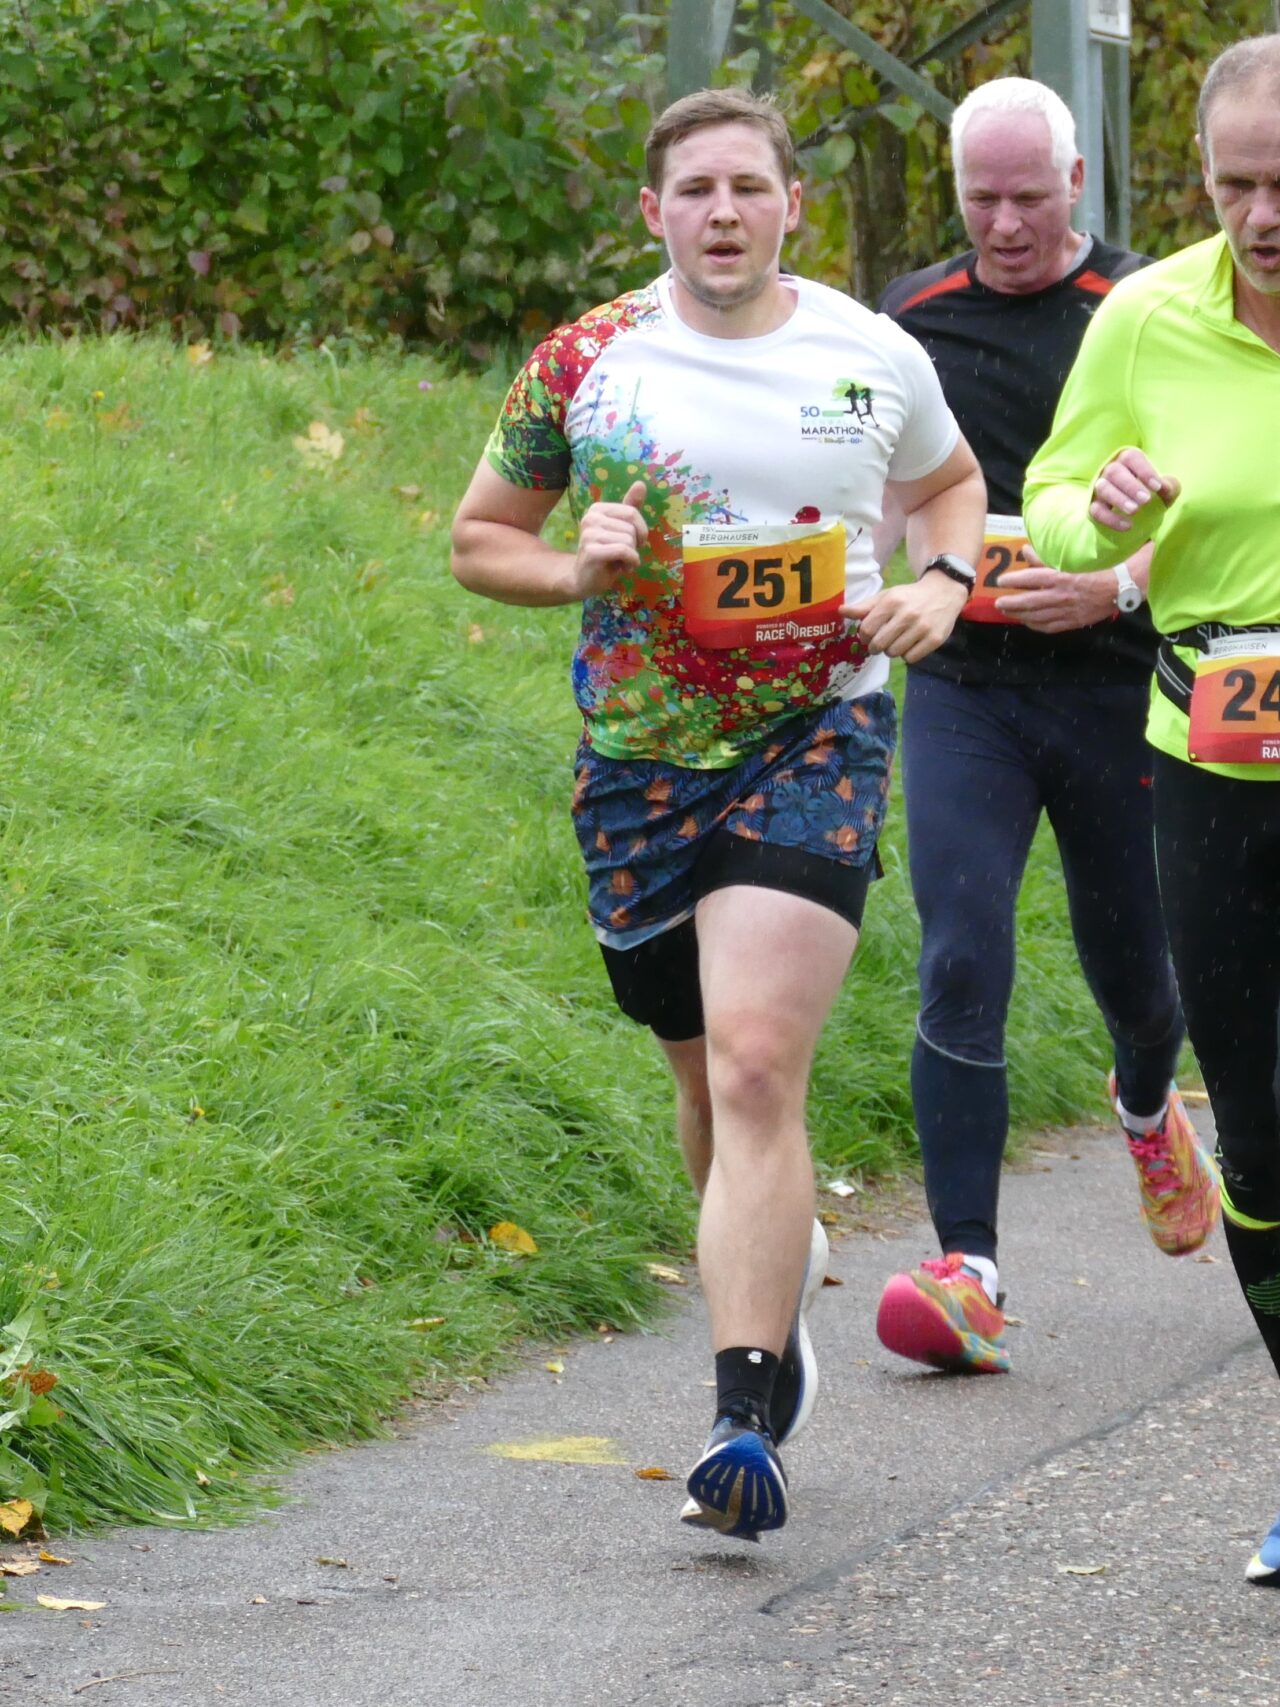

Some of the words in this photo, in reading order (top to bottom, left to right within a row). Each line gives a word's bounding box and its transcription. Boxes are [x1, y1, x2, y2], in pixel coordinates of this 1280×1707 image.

[800, 406, 820, 417] 50
[801, 427, 864, 435] MARATHON
[717, 556, 812, 608] 251
[756, 629, 785, 642] RACE
[800, 622, 836, 638] RESULT
